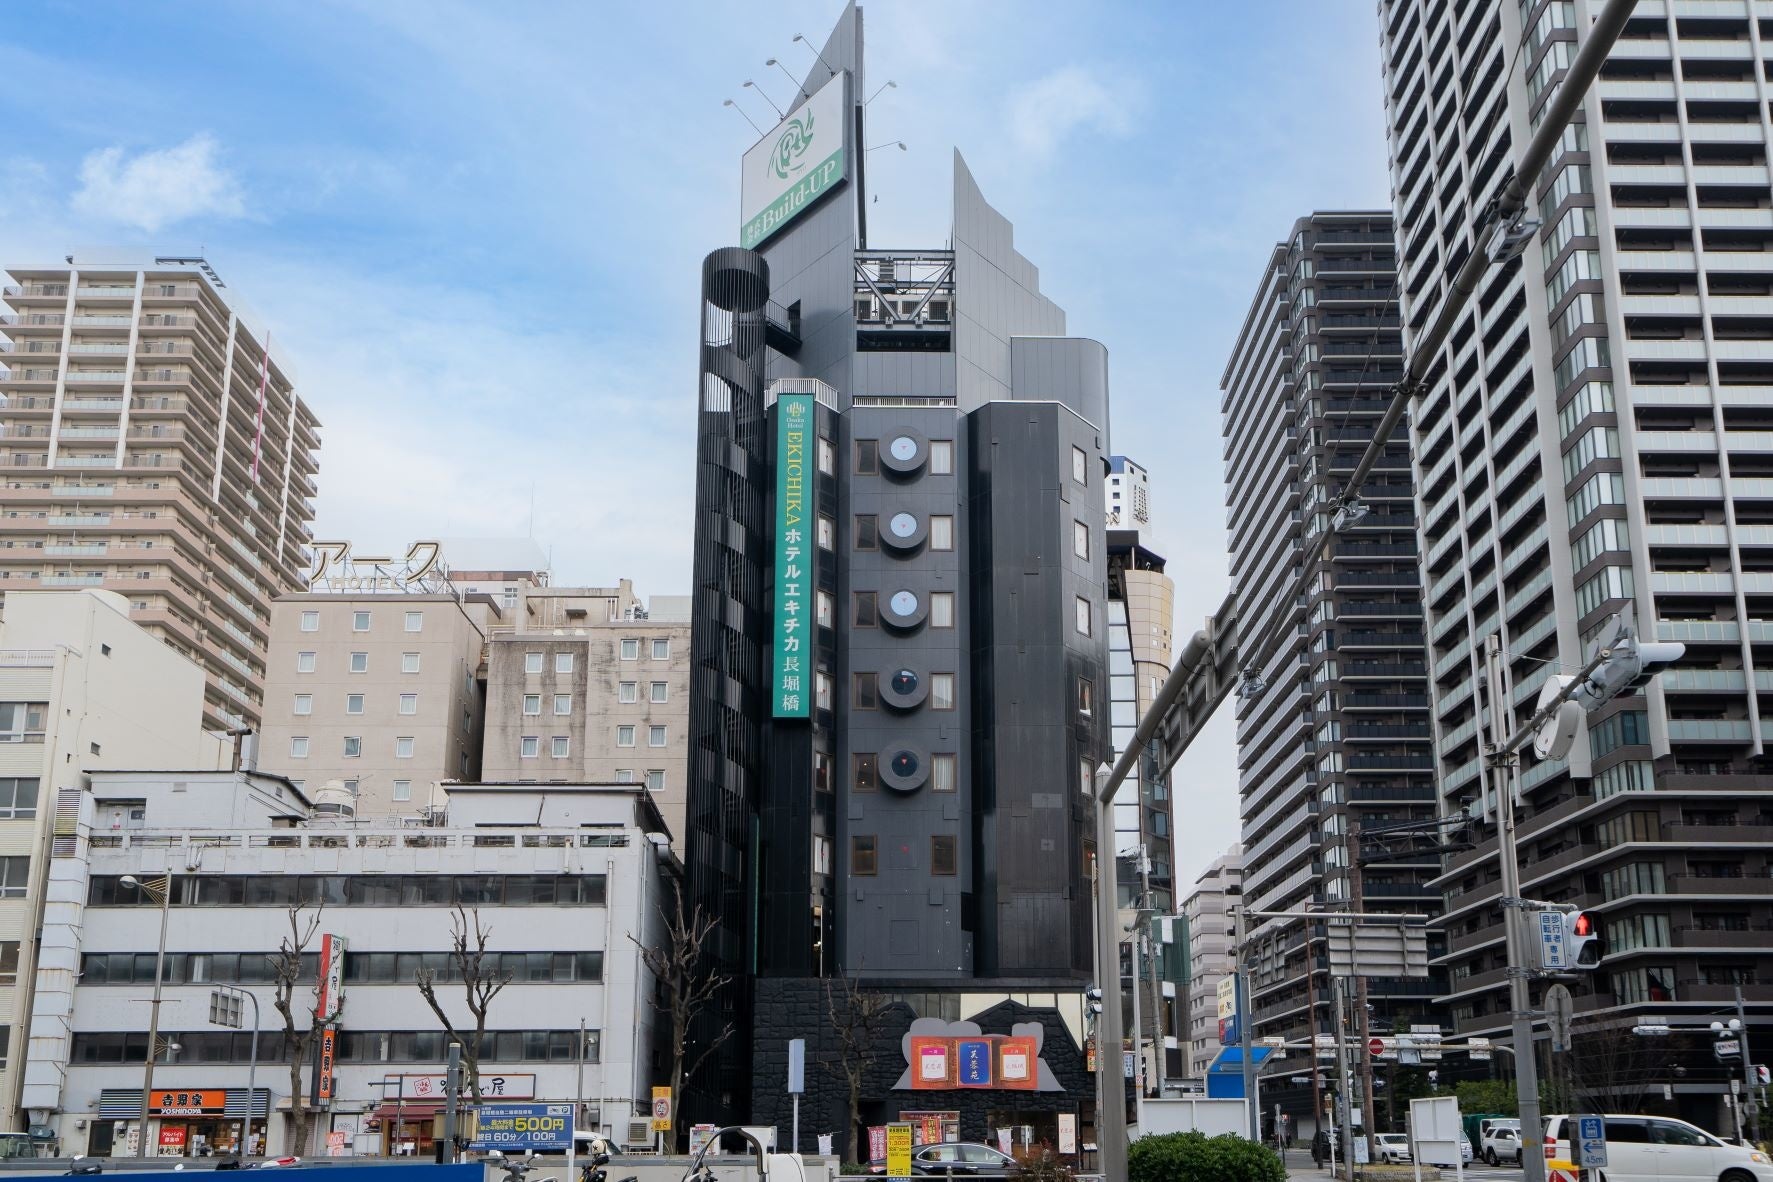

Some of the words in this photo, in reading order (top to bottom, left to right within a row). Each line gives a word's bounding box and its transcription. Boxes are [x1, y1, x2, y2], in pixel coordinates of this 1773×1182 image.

[761, 160, 836, 233] Build-UP
[787, 432, 802, 526] EKICHIKA
[308, 540, 441, 584] アーク
[332, 575, 401, 590] HOTEL
[783, 528, 801, 652] ホテルエキチカ
[782, 656, 799, 711] 長堀橋
[1542, 915, 1552, 943] 自転車
[1551, 915, 1561, 943] 歩行者
[1550, 945, 1559, 964] 専用
[162, 1093, 203, 1106] 吉野家
[515, 1116, 564, 1131] 500円
[1585, 1155, 1603, 1164] 45m
